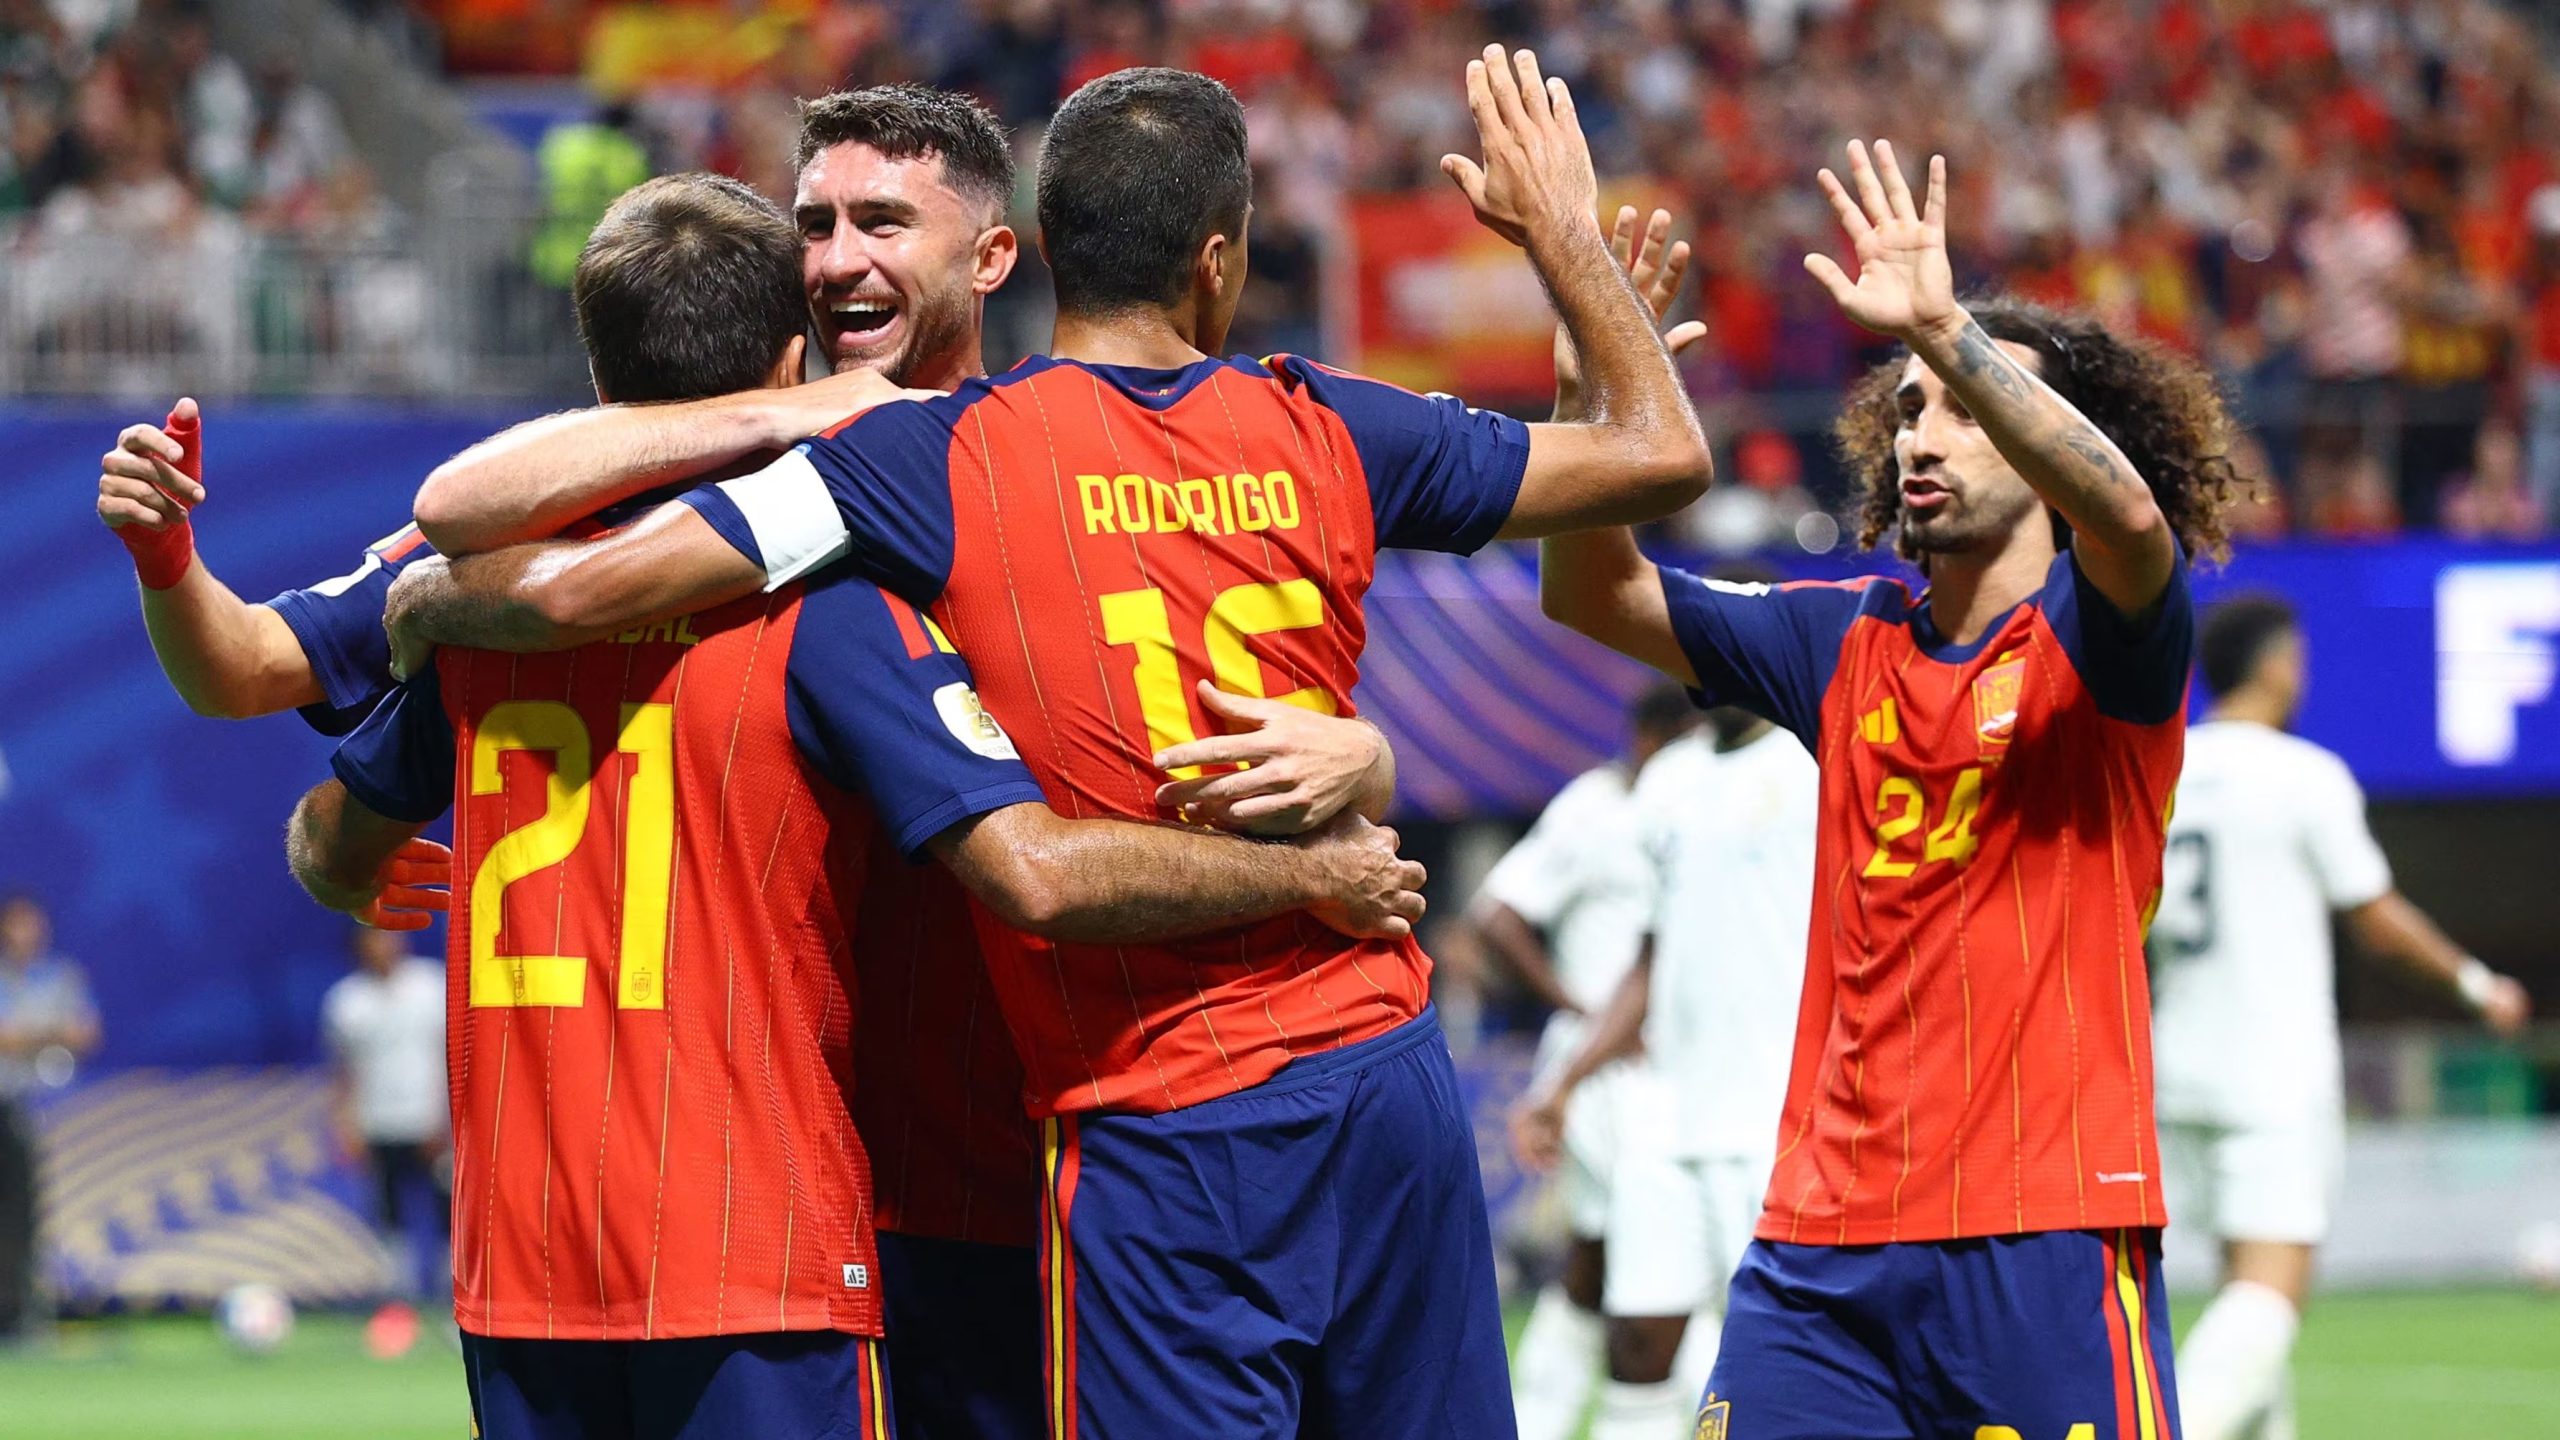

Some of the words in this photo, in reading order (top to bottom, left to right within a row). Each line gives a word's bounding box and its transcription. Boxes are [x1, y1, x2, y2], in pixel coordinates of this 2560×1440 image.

[1075, 470, 1300, 536] RODRIGO
[469, 701, 674, 1010] 21
[1862, 767, 1982, 878] 24
